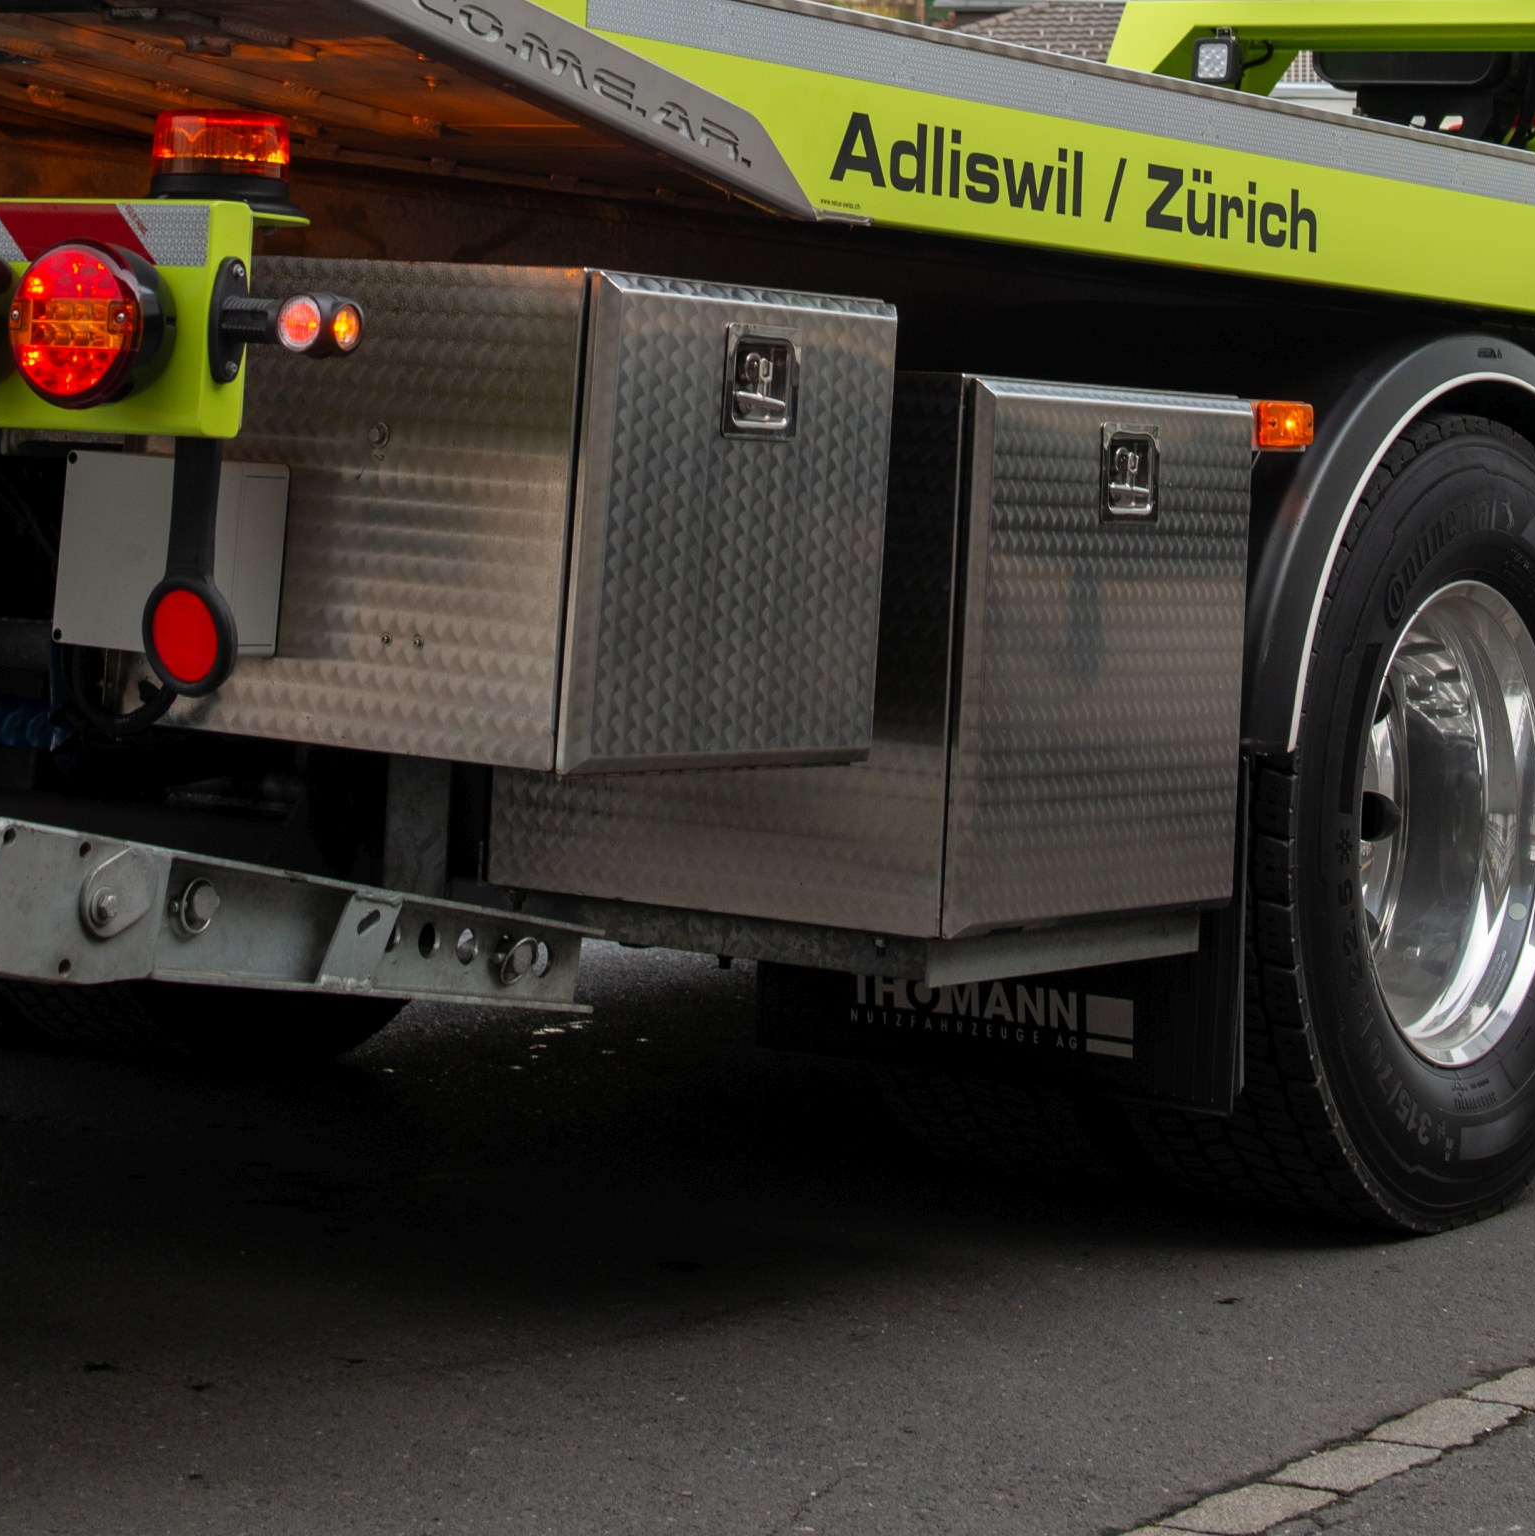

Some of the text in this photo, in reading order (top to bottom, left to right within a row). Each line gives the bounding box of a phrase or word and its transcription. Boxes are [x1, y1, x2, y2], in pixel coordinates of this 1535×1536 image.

[829, 111, 1318, 253] Adliswil / Zürich
[850, 1008, 1078, 1051] NUTZFAHRZEUGE AG
